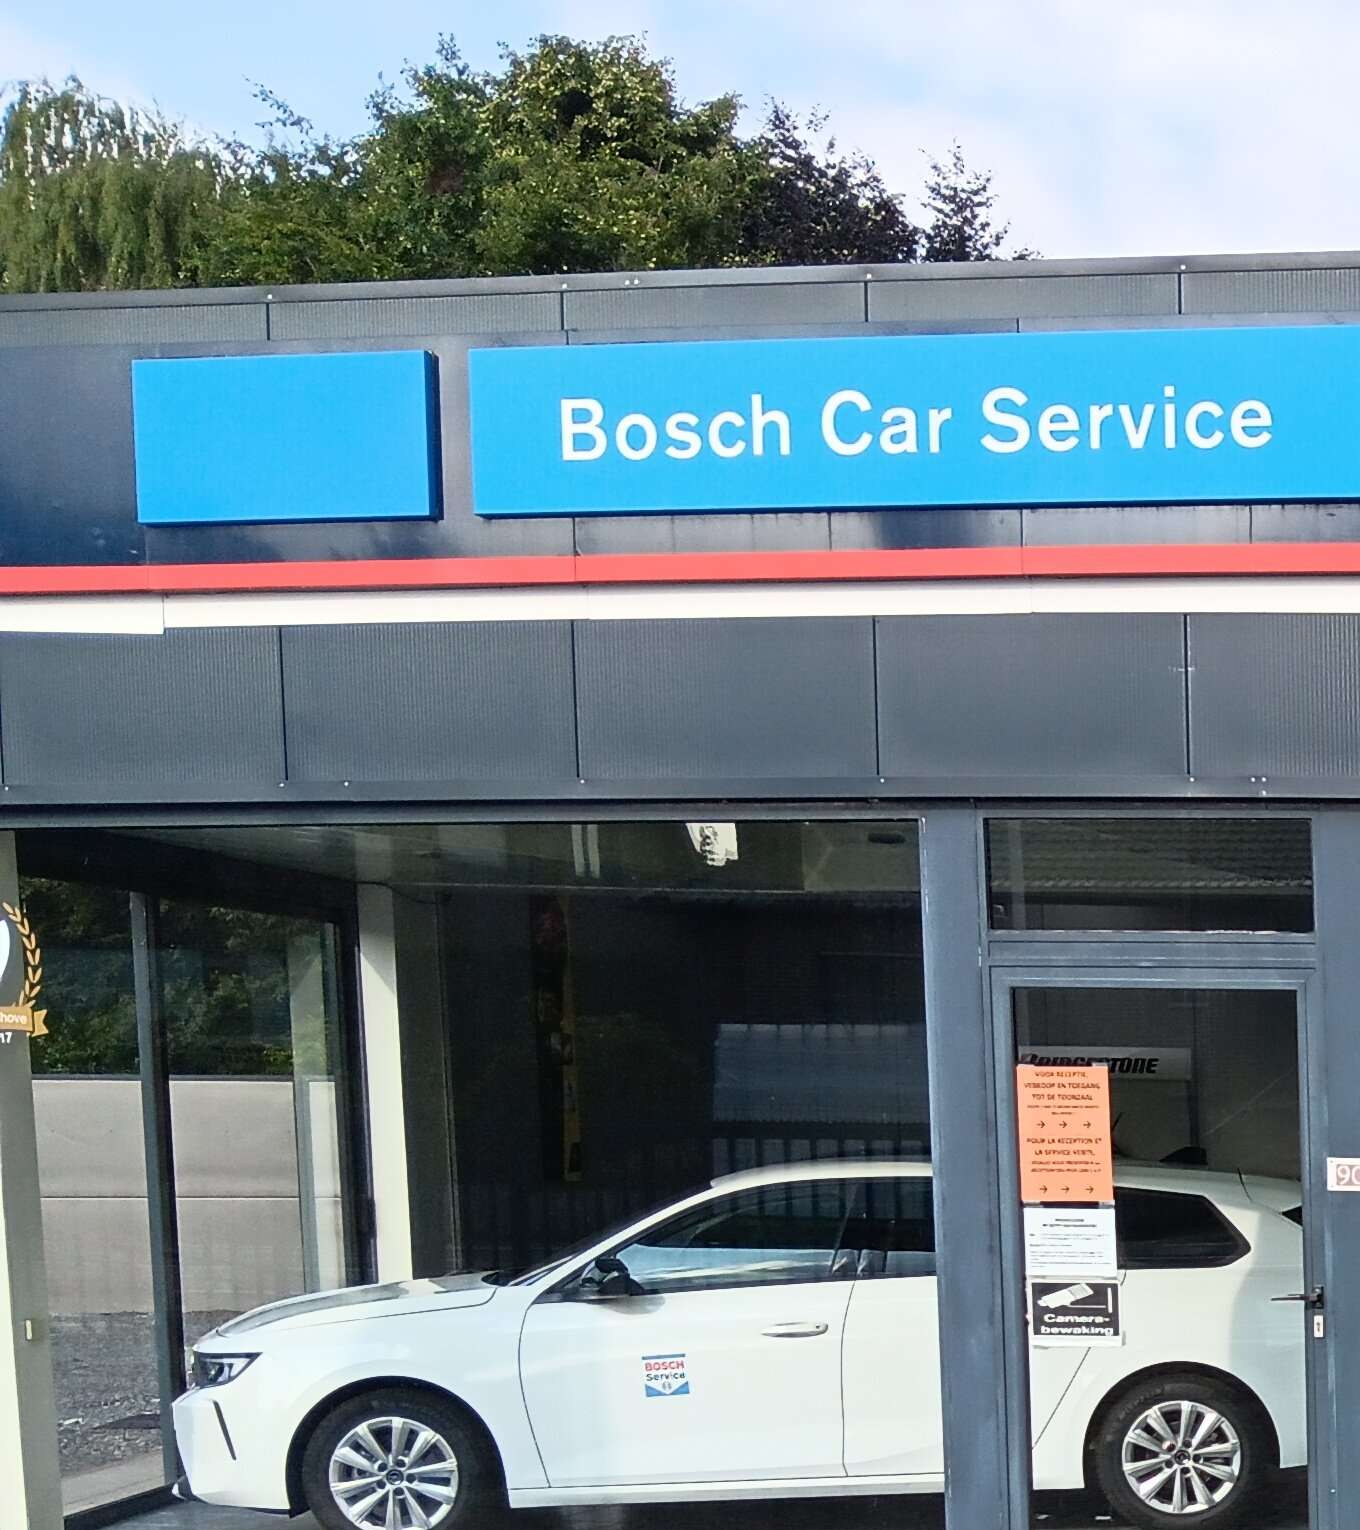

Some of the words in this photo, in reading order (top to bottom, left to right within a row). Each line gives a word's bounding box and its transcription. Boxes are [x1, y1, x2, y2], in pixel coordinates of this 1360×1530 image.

[561, 394, 790, 460] Bosch
[822, 390, 951, 455] Car
[981, 386, 1271, 453] Service
[0, 1012, 27, 1025] hove
[1043, 1313, 1110, 1324] Camera-
[1040, 1325, 1114, 1336] bewaking
[645, 1360, 685, 1371] BOSCH
[646, 1372, 685, 1381] Service
